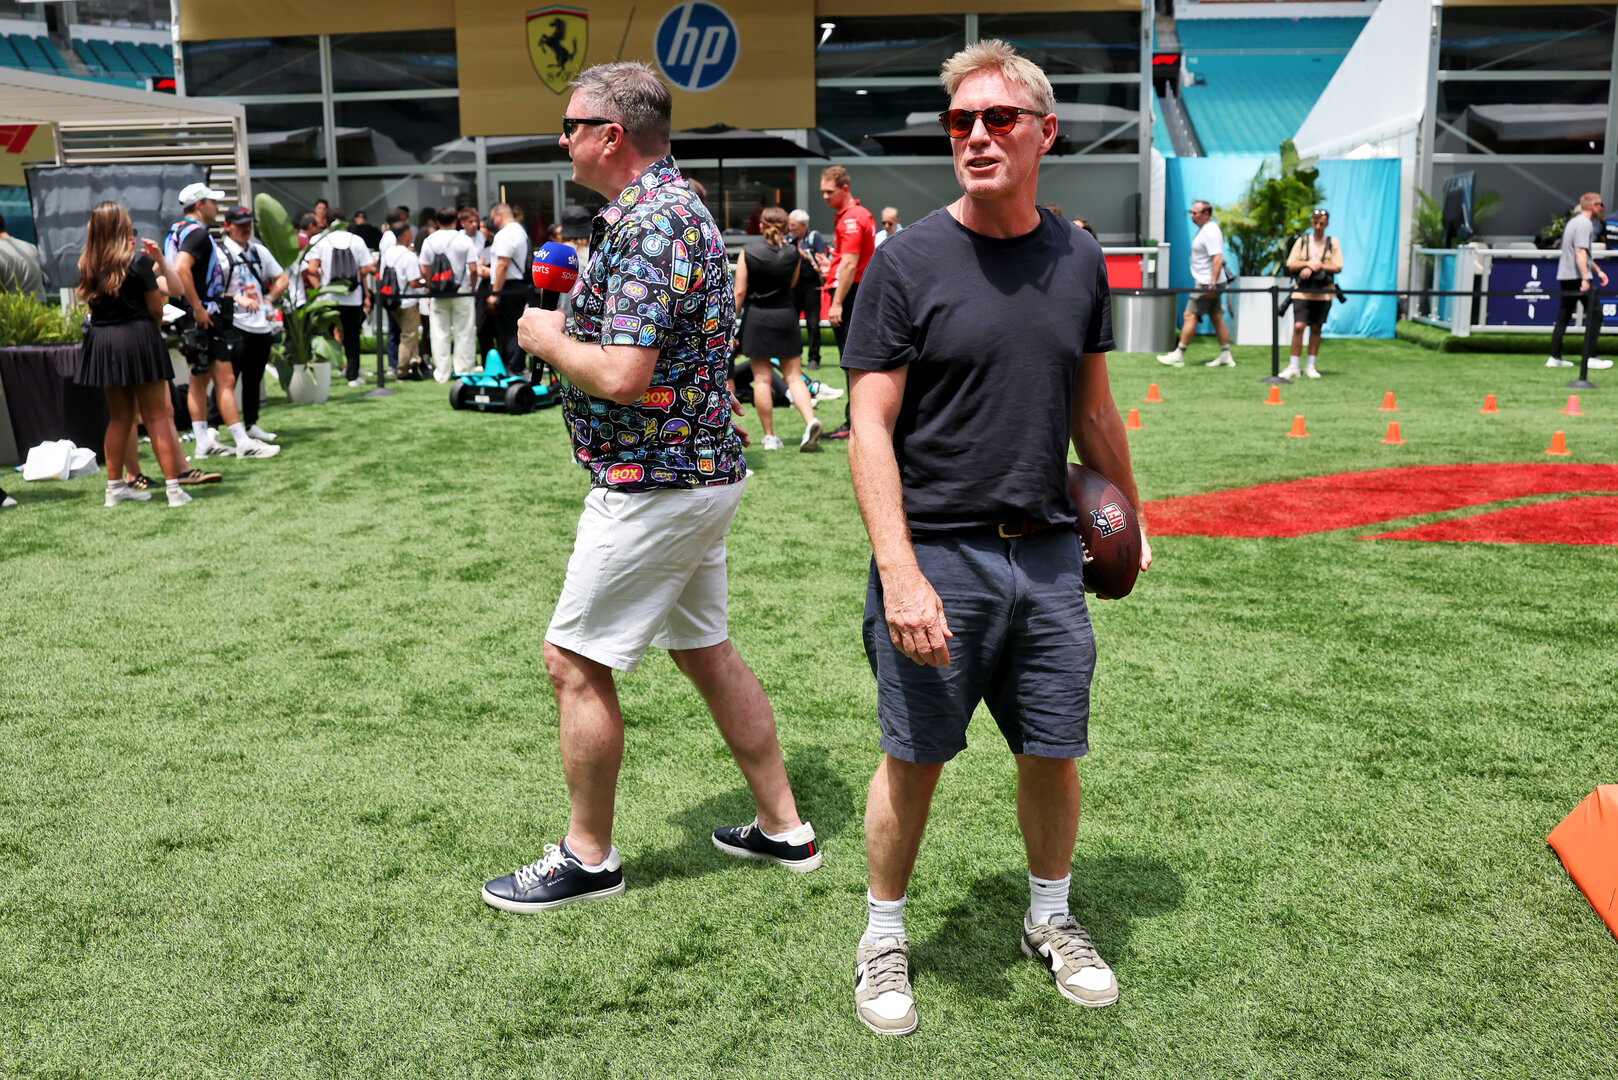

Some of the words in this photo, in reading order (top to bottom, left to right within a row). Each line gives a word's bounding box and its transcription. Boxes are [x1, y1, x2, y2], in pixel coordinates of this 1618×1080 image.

[666, 2, 729, 90] hp
[532, 264, 549, 275] ports
[675, 277, 685, 290] P3
[626, 284, 643, 296] POS
[642, 391, 670, 404] BOX
[621, 433, 635, 444] POS
[701, 460, 712, 471] P3
[611, 468, 638, 480] BOX
[654, 470, 673, 480] POS
[1105, 506, 1124, 531] NFL
